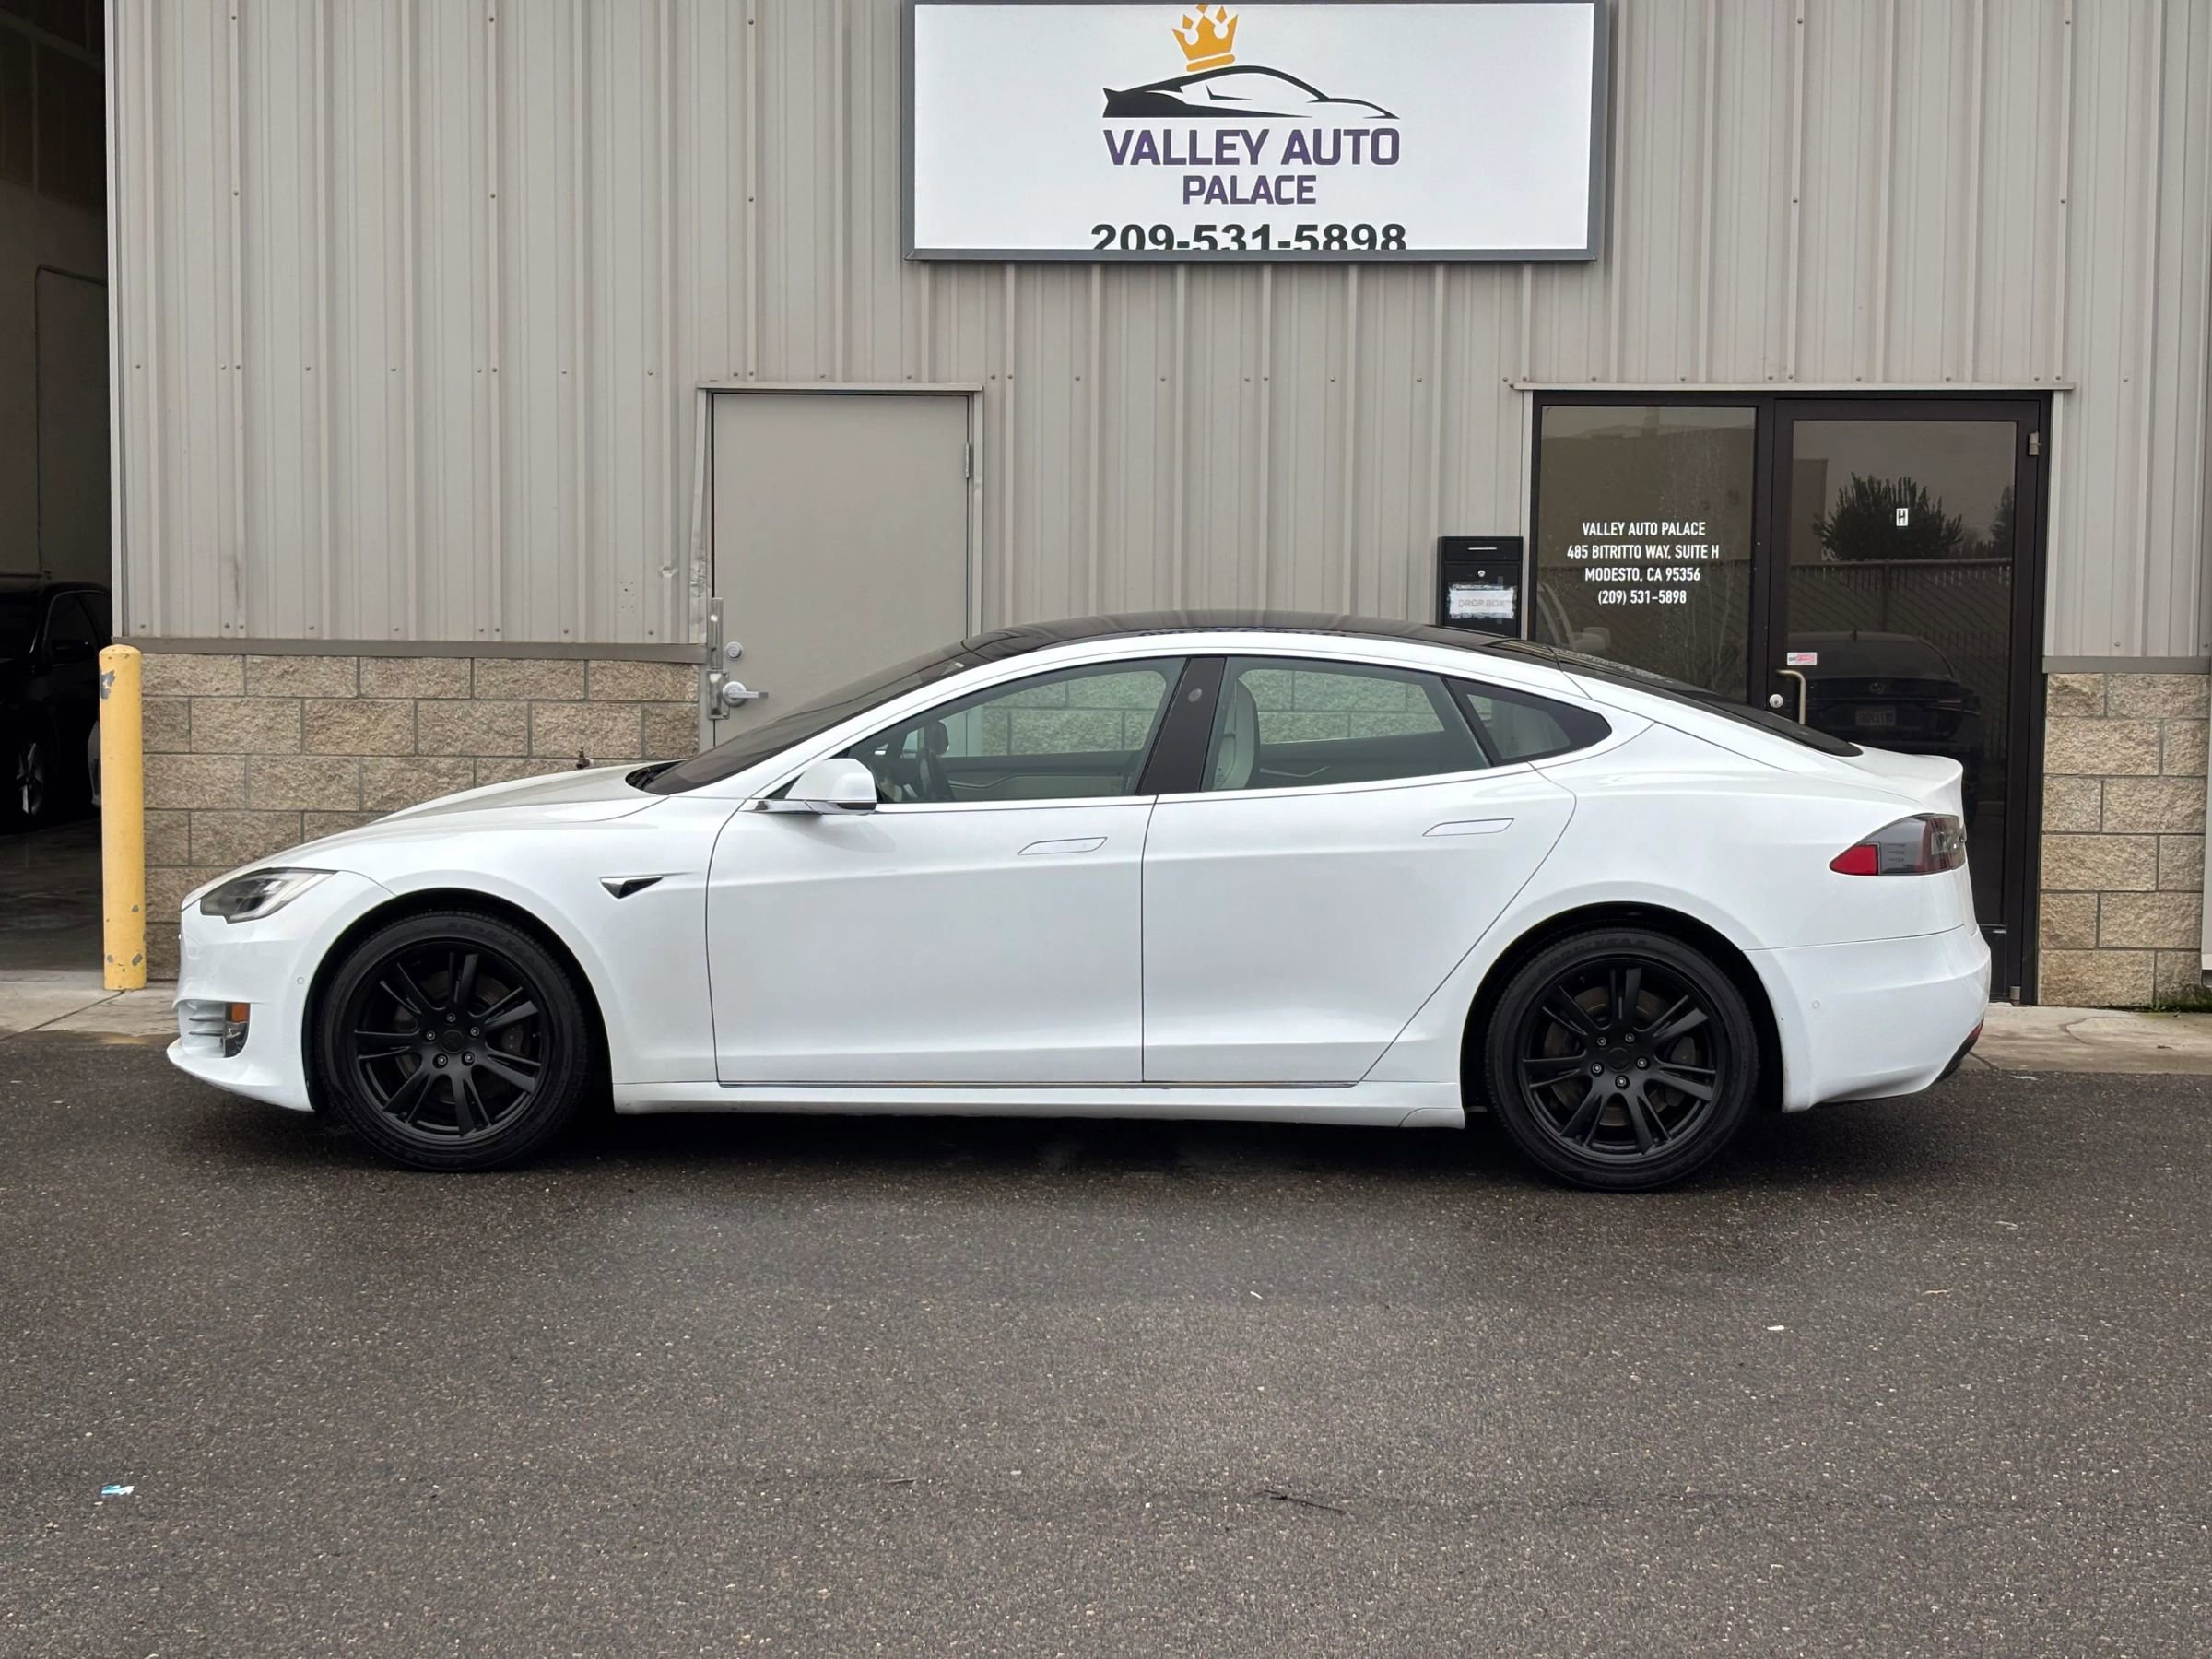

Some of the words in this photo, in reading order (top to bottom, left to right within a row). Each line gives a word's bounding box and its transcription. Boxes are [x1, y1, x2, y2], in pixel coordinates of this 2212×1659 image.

[1102, 128, 1270, 166] VALLEY
[1280, 127, 1400, 166] AUTO
[1182, 174, 1317, 206] PALACE
[1090, 223, 1406, 251] 209-531-5898
[1898, 509, 1906, 524] H
[1582, 522, 1626, 536] VALLEY
[1628, 522, 1658, 536] AUTO
[1661, 522, 1706, 536] PALACE
[1567, 544, 1588, 559] 485
[1591, 544, 1642, 559] BITRITTO
[1645, 544, 1672, 560] WAY,
[1675, 544, 1709, 559] SUITE
[1711, 544, 1720, 559] H
[1584, 567, 1643, 582] MODESTO,
[1646, 567, 1663, 582] CA
[1665, 567, 1701, 582] 95356
[1458, 599, 1484, 607] DROP
[1486, 599, 1505, 607] BOX
[1597, 590, 1627, 606] (209)
[1630, 590, 1688, 605] 531-5898
